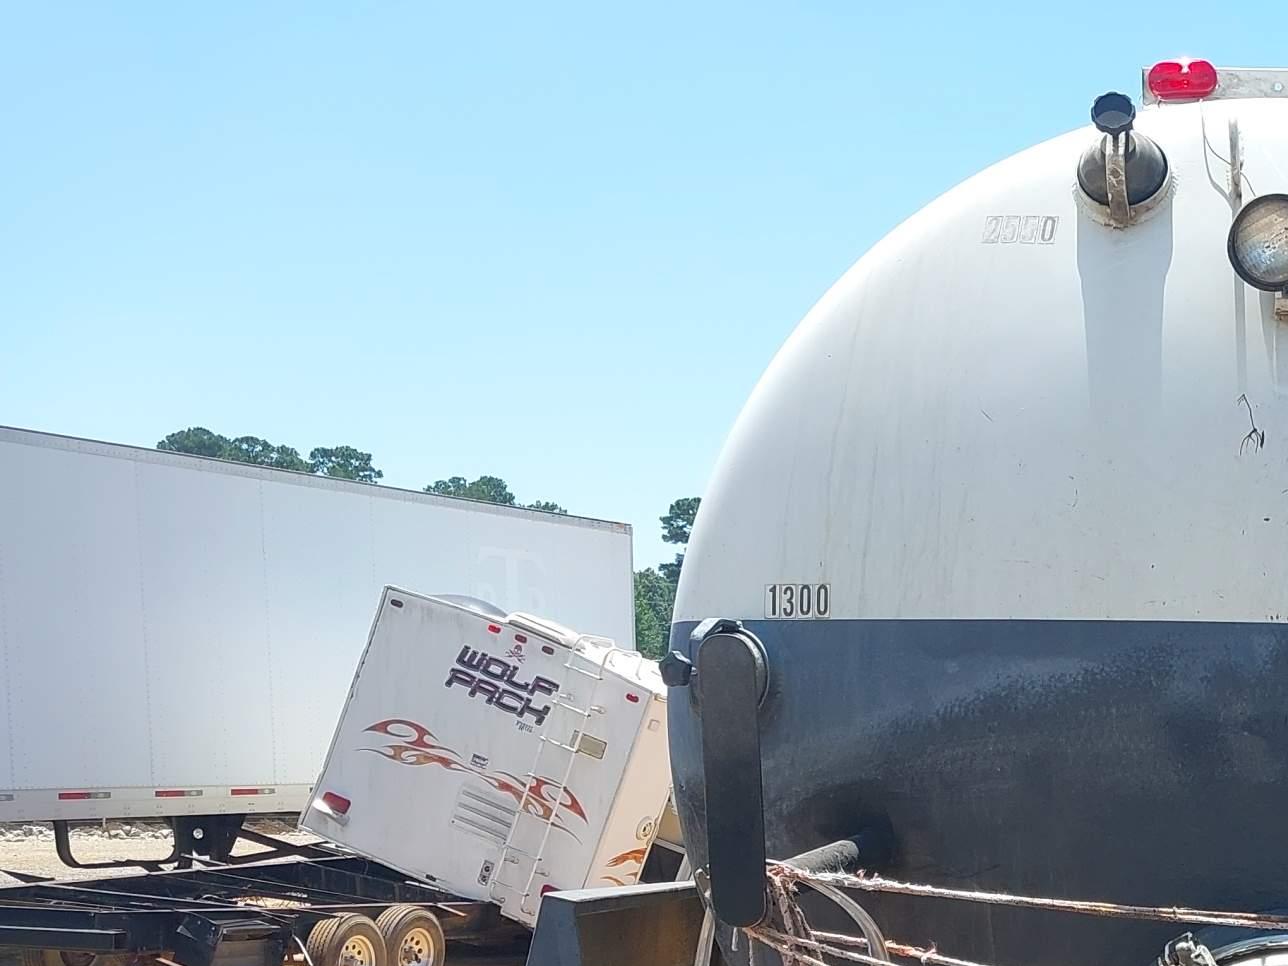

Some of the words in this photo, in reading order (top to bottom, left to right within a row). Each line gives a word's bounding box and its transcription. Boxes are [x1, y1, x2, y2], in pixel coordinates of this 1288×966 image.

[767, 584, 829, 617] 1300
[456, 645, 560, 696] WOLF
[445, 668, 551, 727] PACK
